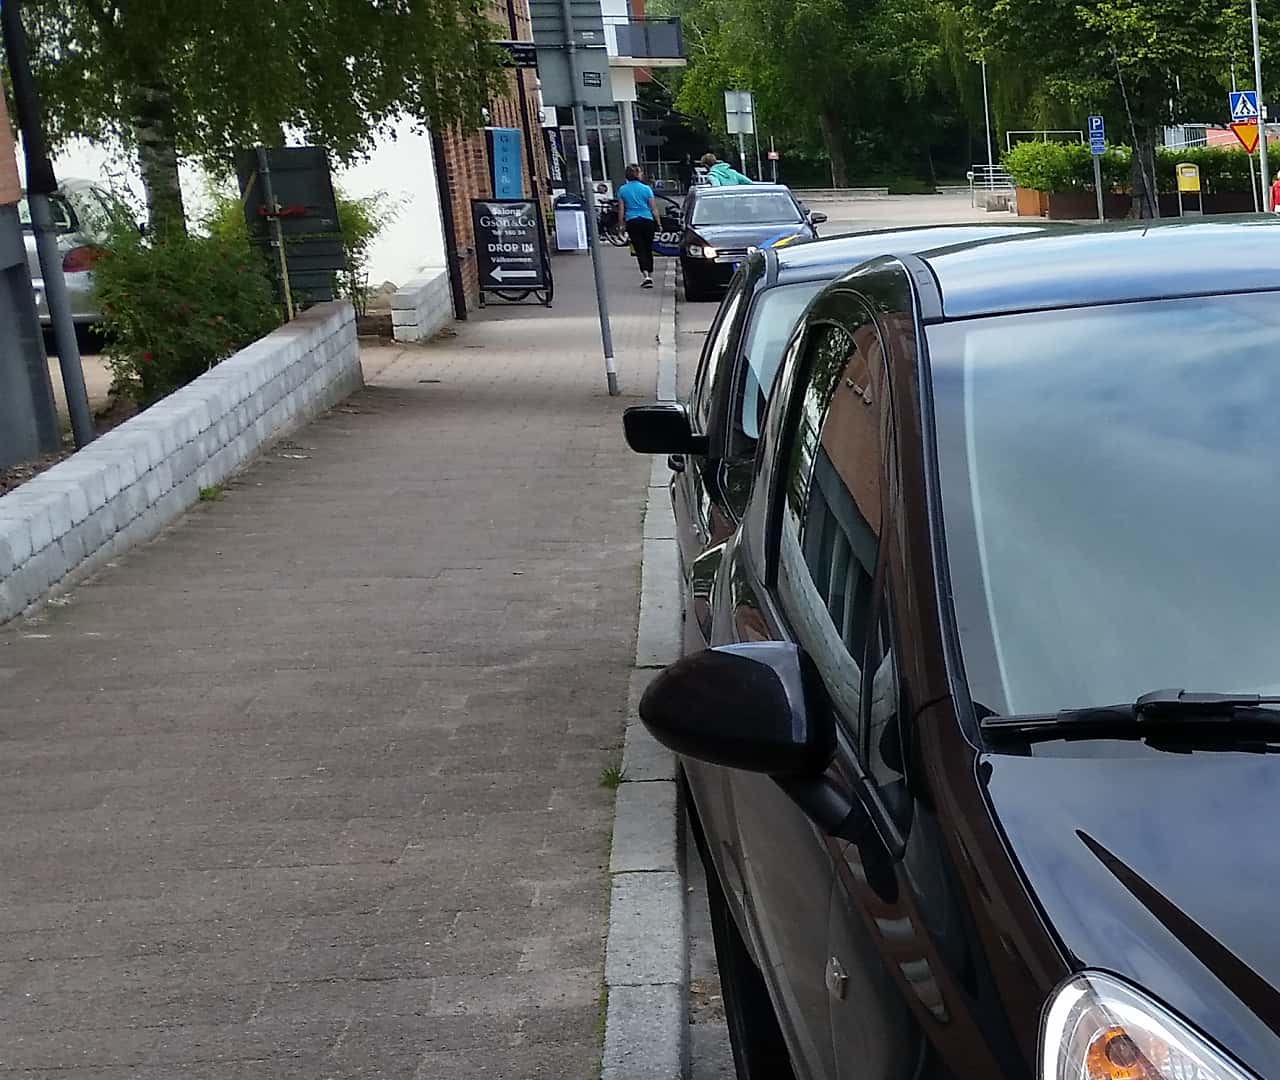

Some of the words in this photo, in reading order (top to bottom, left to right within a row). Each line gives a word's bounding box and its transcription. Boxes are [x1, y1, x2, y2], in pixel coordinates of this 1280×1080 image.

[1092, 118, 1101, 130] P
[488, 243, 519, 252] DROP
[521, 243, 534, 252] IN
